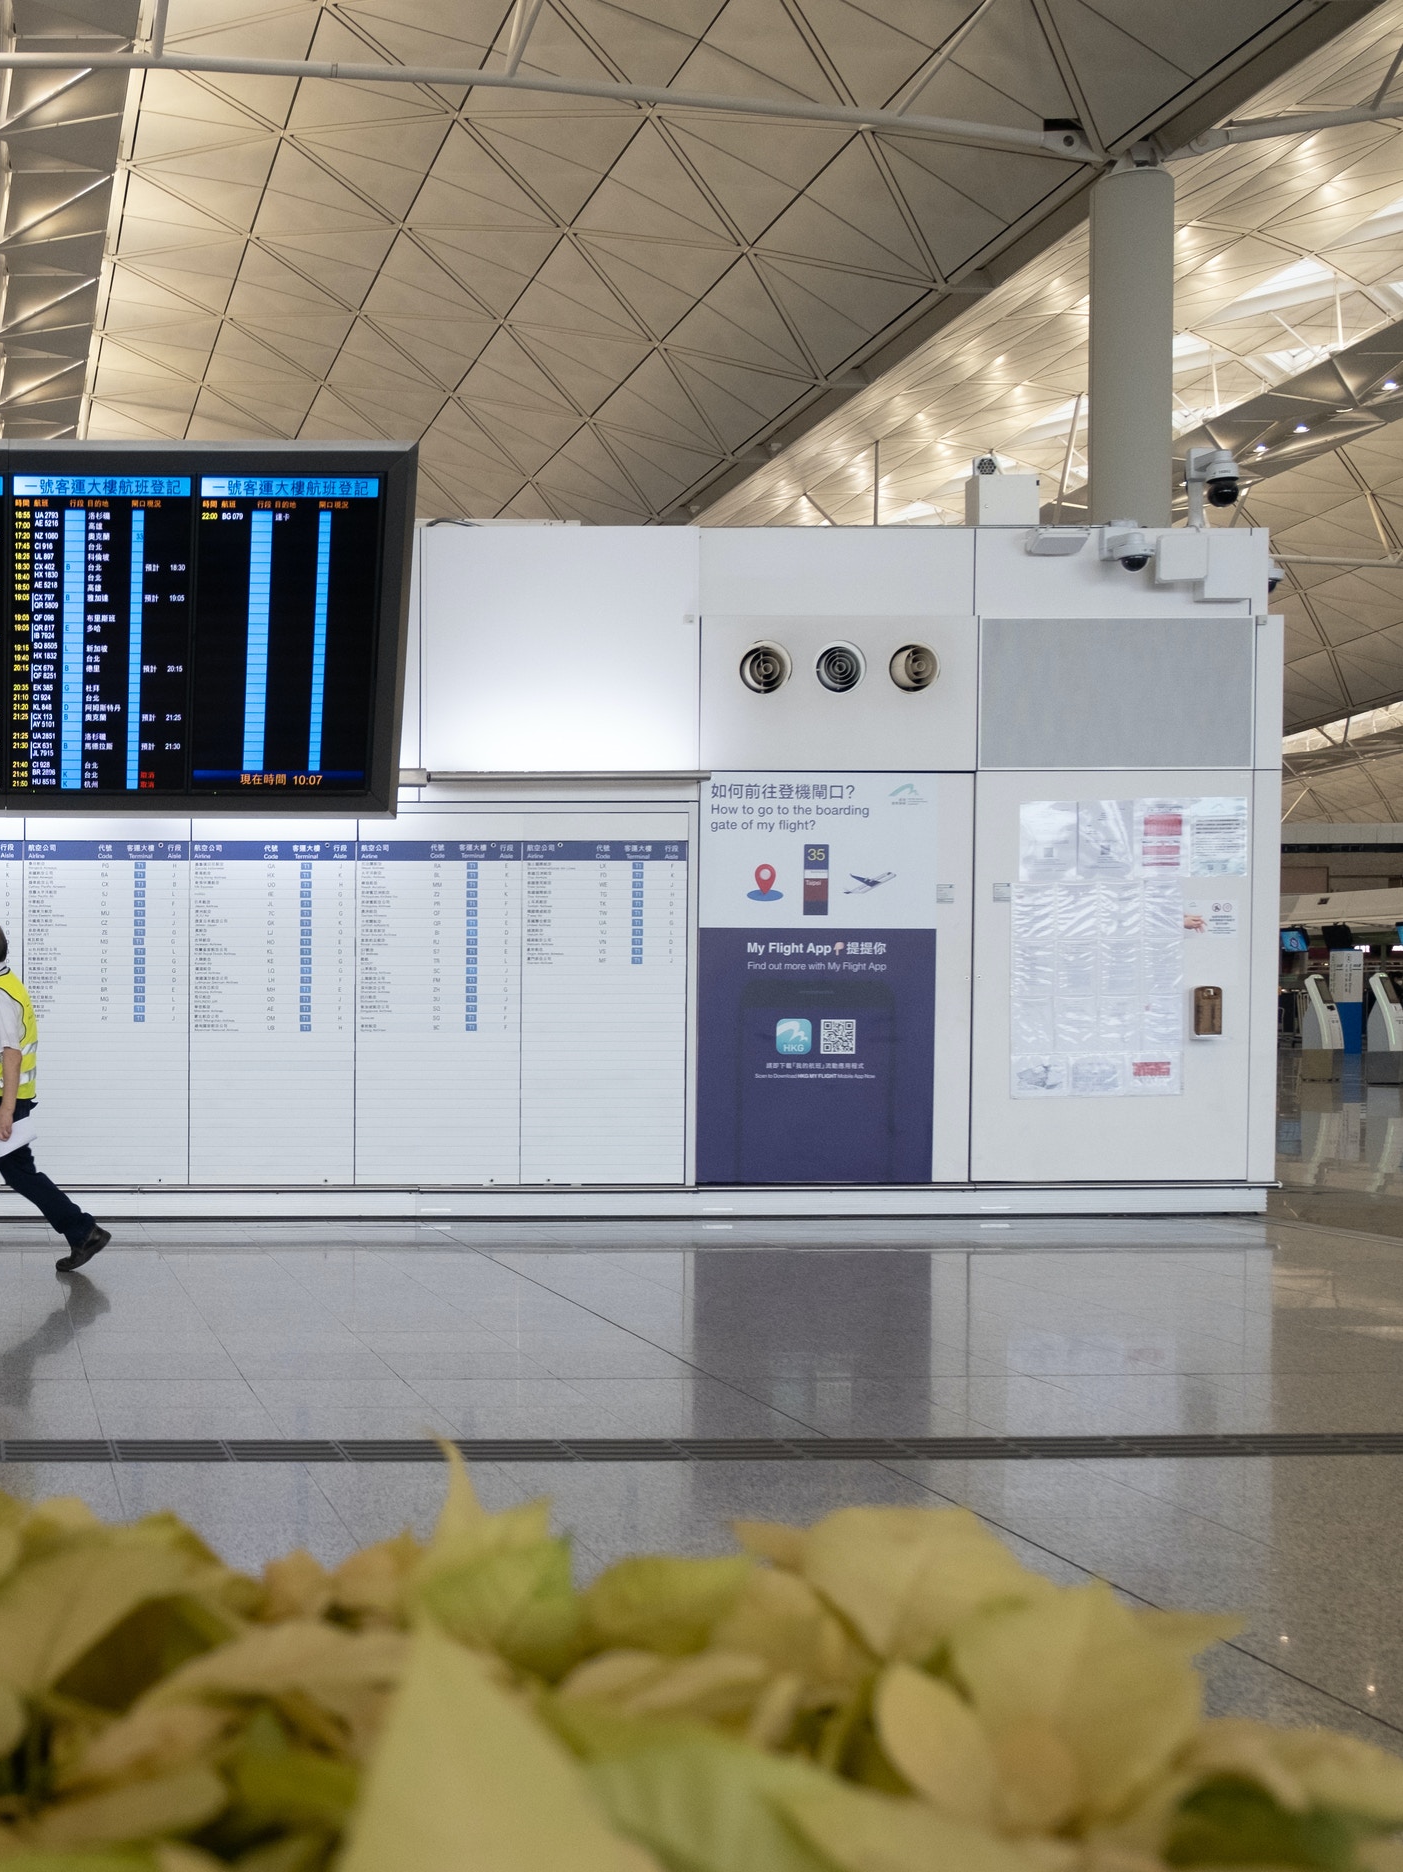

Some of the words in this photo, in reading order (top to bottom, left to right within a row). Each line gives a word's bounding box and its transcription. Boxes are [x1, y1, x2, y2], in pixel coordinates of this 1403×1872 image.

[25, 479, 181, 494] 一號客運大樓航班登記
[213, 480, 368, 495] 一號客運大樓航班登記
[240, 773, 286, 785] 現在時間
[293, 775, 322, 785] 10:07
[711, 805, 738, 815] How
[742, 806, 754, 815] to
[758, 807, 773, 817] go
[777, 806, 789, 815] to
[793, 805, 812, 815] the
[816, 805, 869, 817] boarding
[711, 821, 737, 832] gate
[741, 820, 753, 830] of
[757, 822, 775, 832] my
[779, 819, 816, 832] flight?
[28, 844, 56, 852] 航空公司
[99, 844, 112, 852] 代號
[127, 844, 154, 852] 客運大樓
[168, 844, 181, 852] 行段
[807, 849, 825, 860] 35
[747, 943, 765, 955] My
[769, 942, 803, 955] Flight
[807, 943, 831, 956] App
[847, 942, 886, 955] 提提你
[748, 962, 766, 970] Find
[808, 962, 825, 970] with
[828, 963, 839, 972] My
[843, 962, 866, 972] Flight
[868, 963, 886, 972] App
